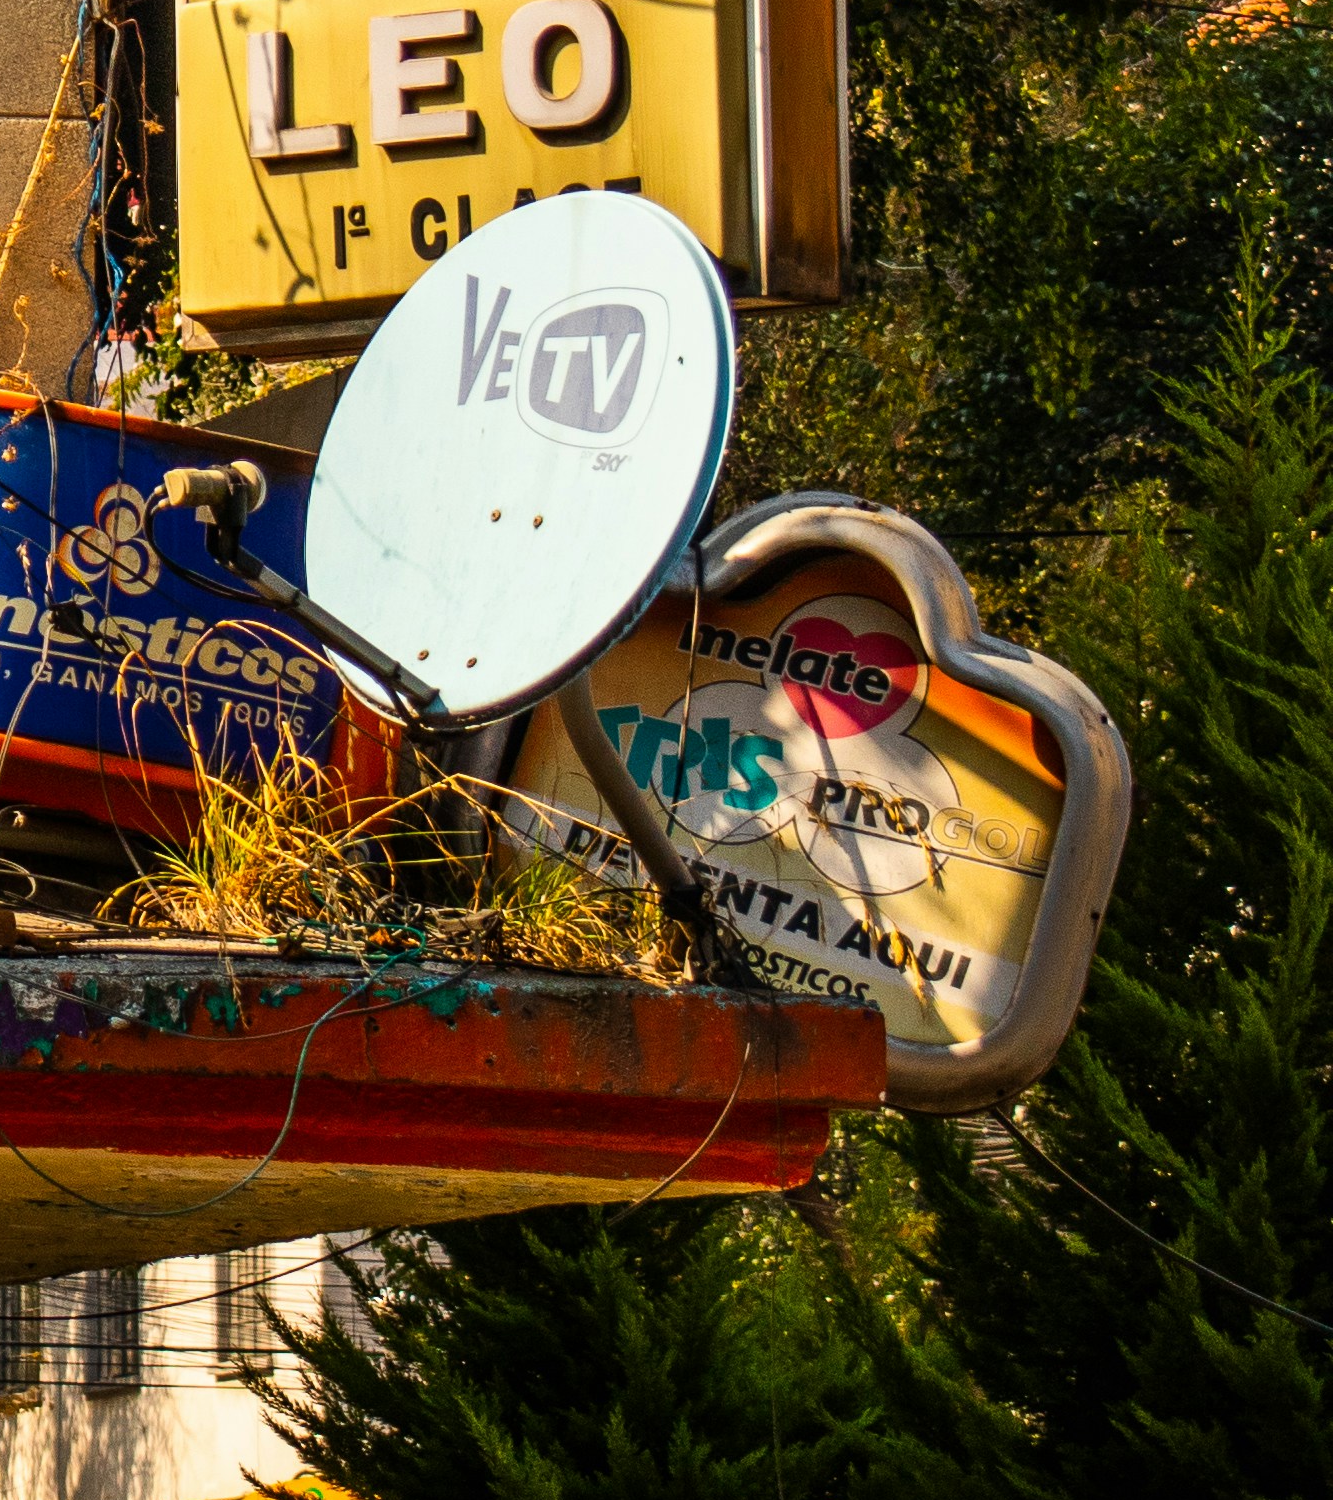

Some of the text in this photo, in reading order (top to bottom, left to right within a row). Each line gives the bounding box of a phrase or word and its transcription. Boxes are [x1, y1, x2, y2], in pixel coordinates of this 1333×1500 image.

[36, 660, 202, 714] GANAMOS
[678, 620, 892, 704] melate
[835, 920, 972, 990] AQUI
